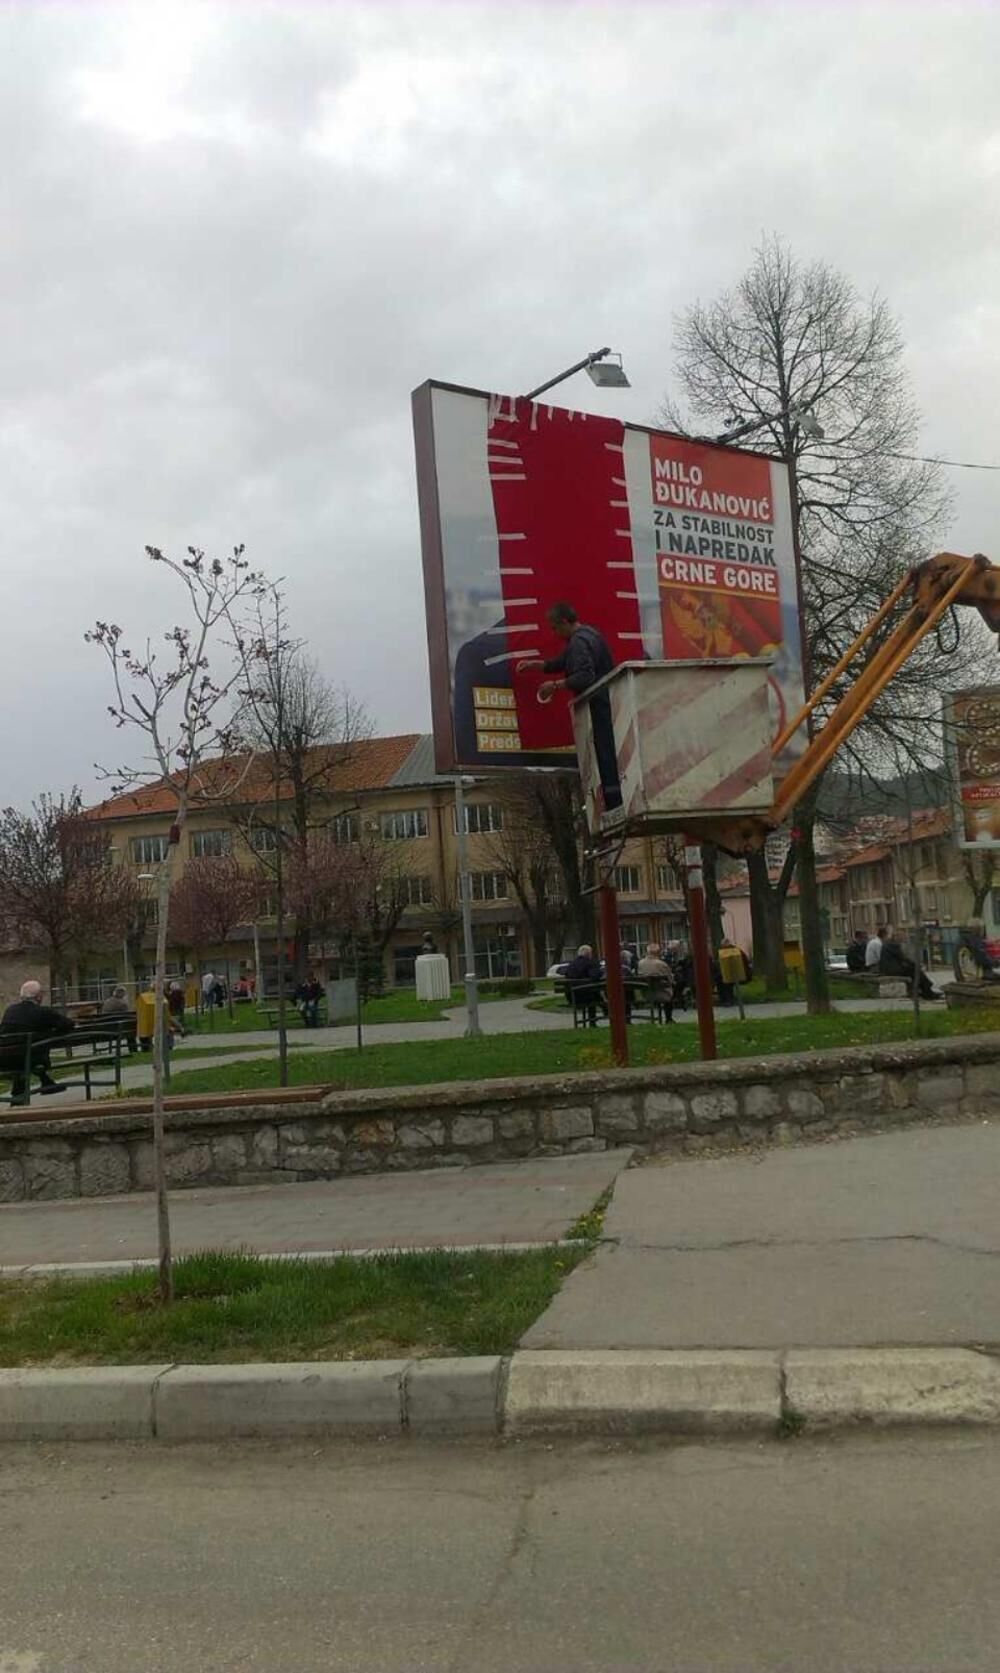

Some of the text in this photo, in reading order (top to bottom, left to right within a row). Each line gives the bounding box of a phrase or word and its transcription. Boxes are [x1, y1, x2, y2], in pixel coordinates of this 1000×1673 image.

[654, 458, 703, 486] MILO
[655, 481, 771, 520] ĐUKANOVIĆ
[653, 510, 775, 544] ZA STABILNOST
[655, 530, 777, 567] I NAPREDAK
[660, 559, 777, 593] CRNE GORE
